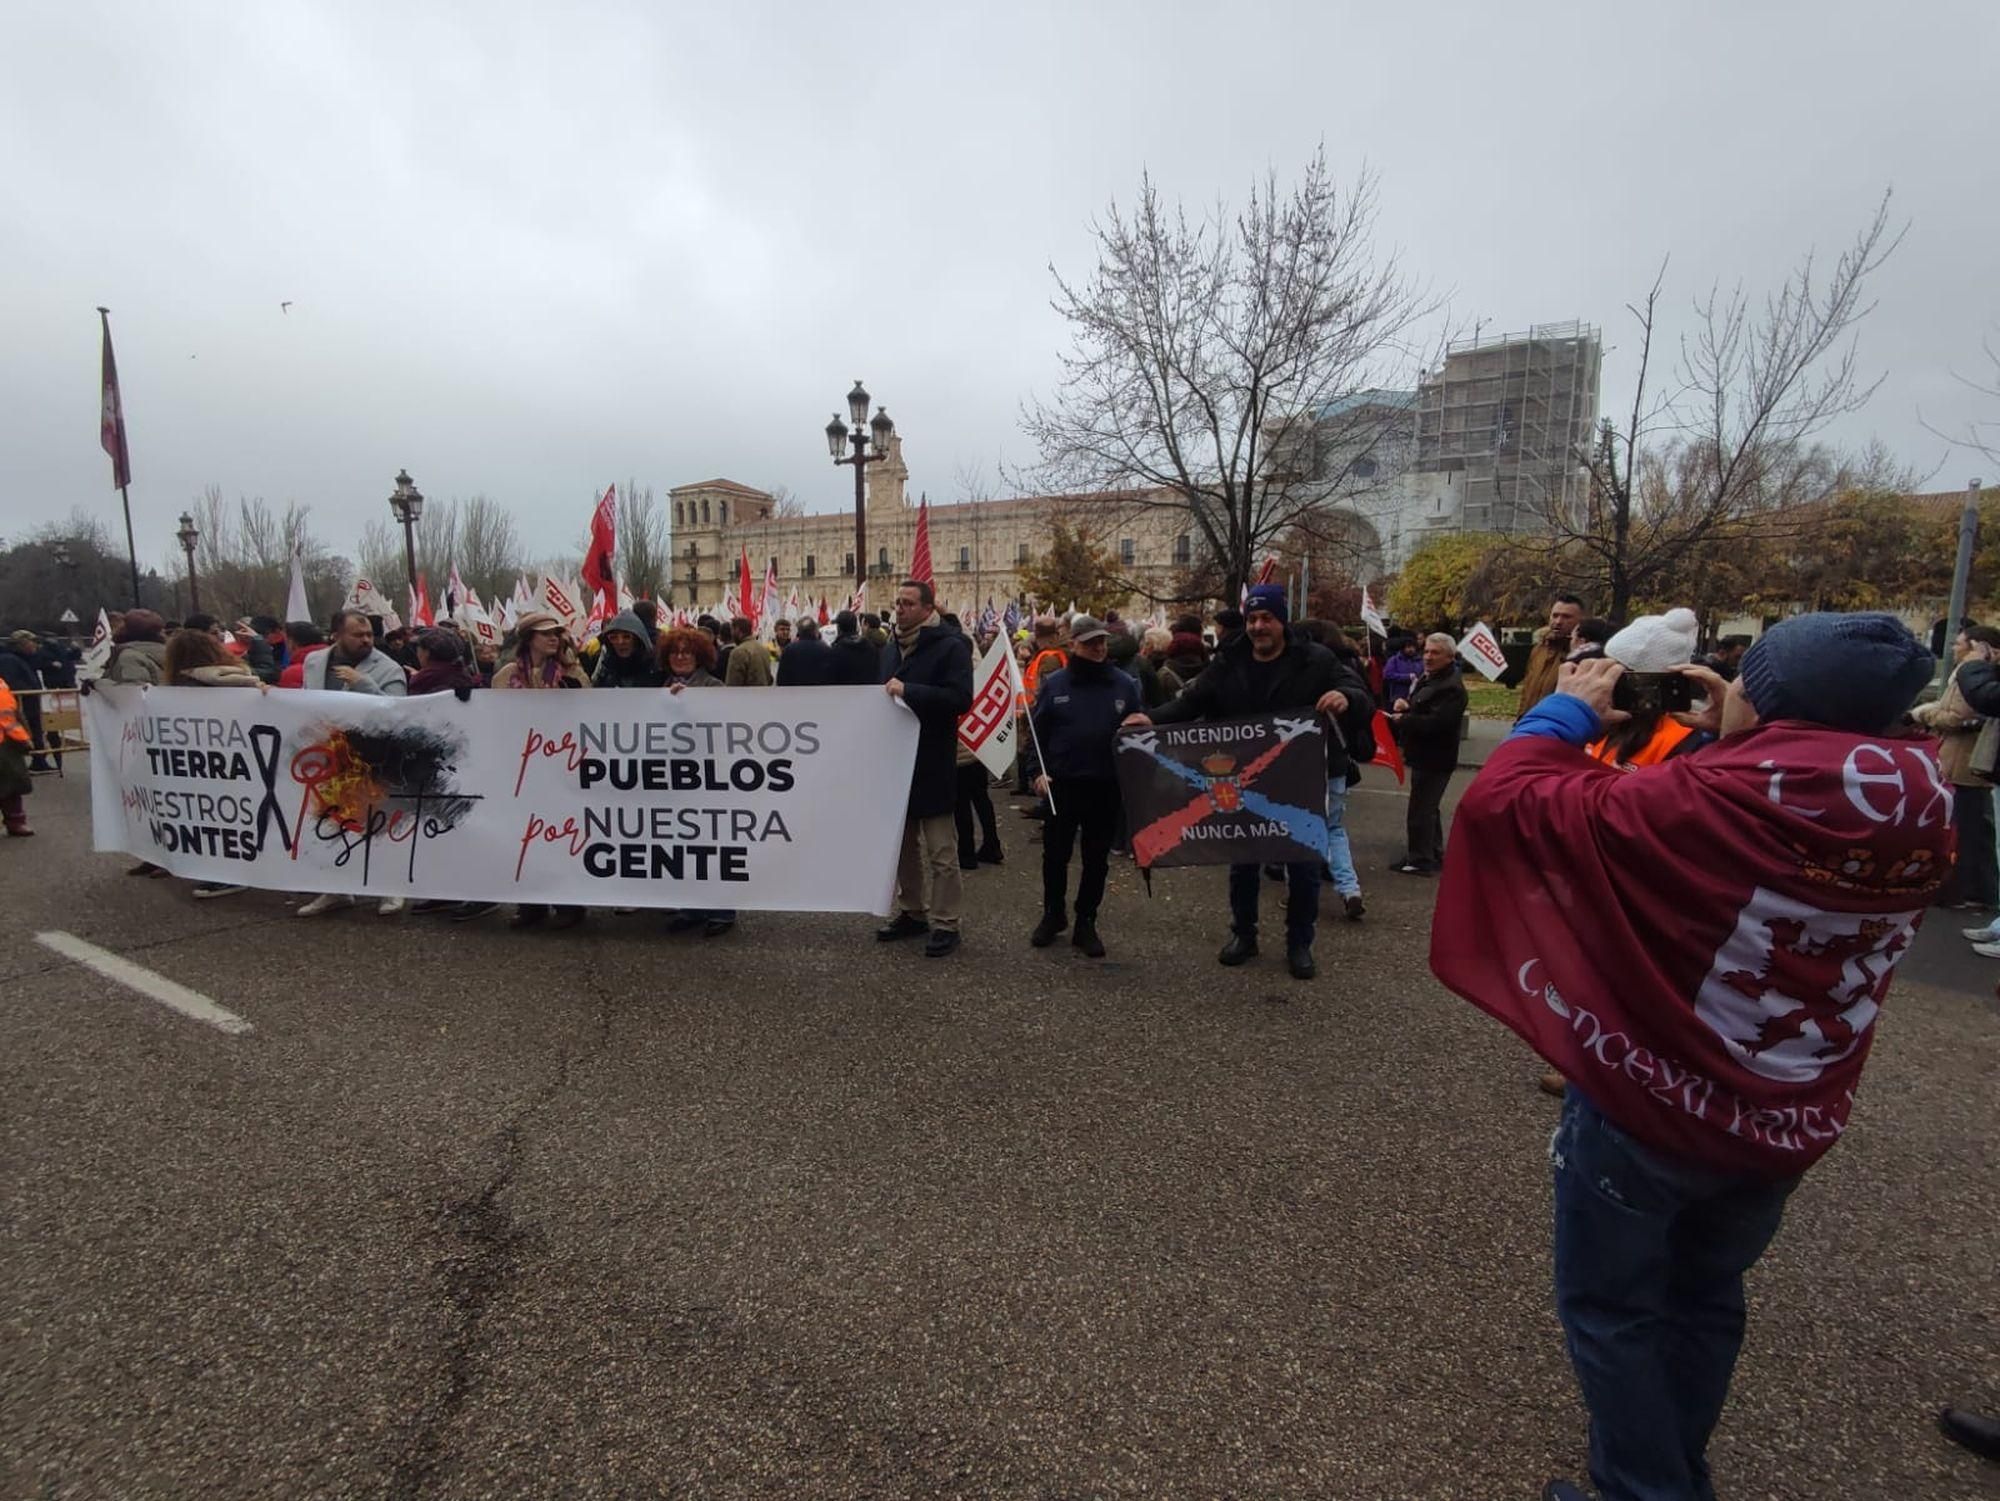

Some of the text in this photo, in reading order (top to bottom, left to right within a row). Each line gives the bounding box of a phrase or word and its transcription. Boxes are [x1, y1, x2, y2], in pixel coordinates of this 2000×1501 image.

[1166, 723, 1267, 746] INCENDIOS
[146, 747, 251, 781] TIERRA
[513, 721, 820, 797] por NUESTROS
[579, 758, 795, 792] PUEBLOS
[514, 806, 792, 882] por NUESTRA
[1181, 823, 1246, 841] NUNCA
[583, 843, 749, 882] GENTE
